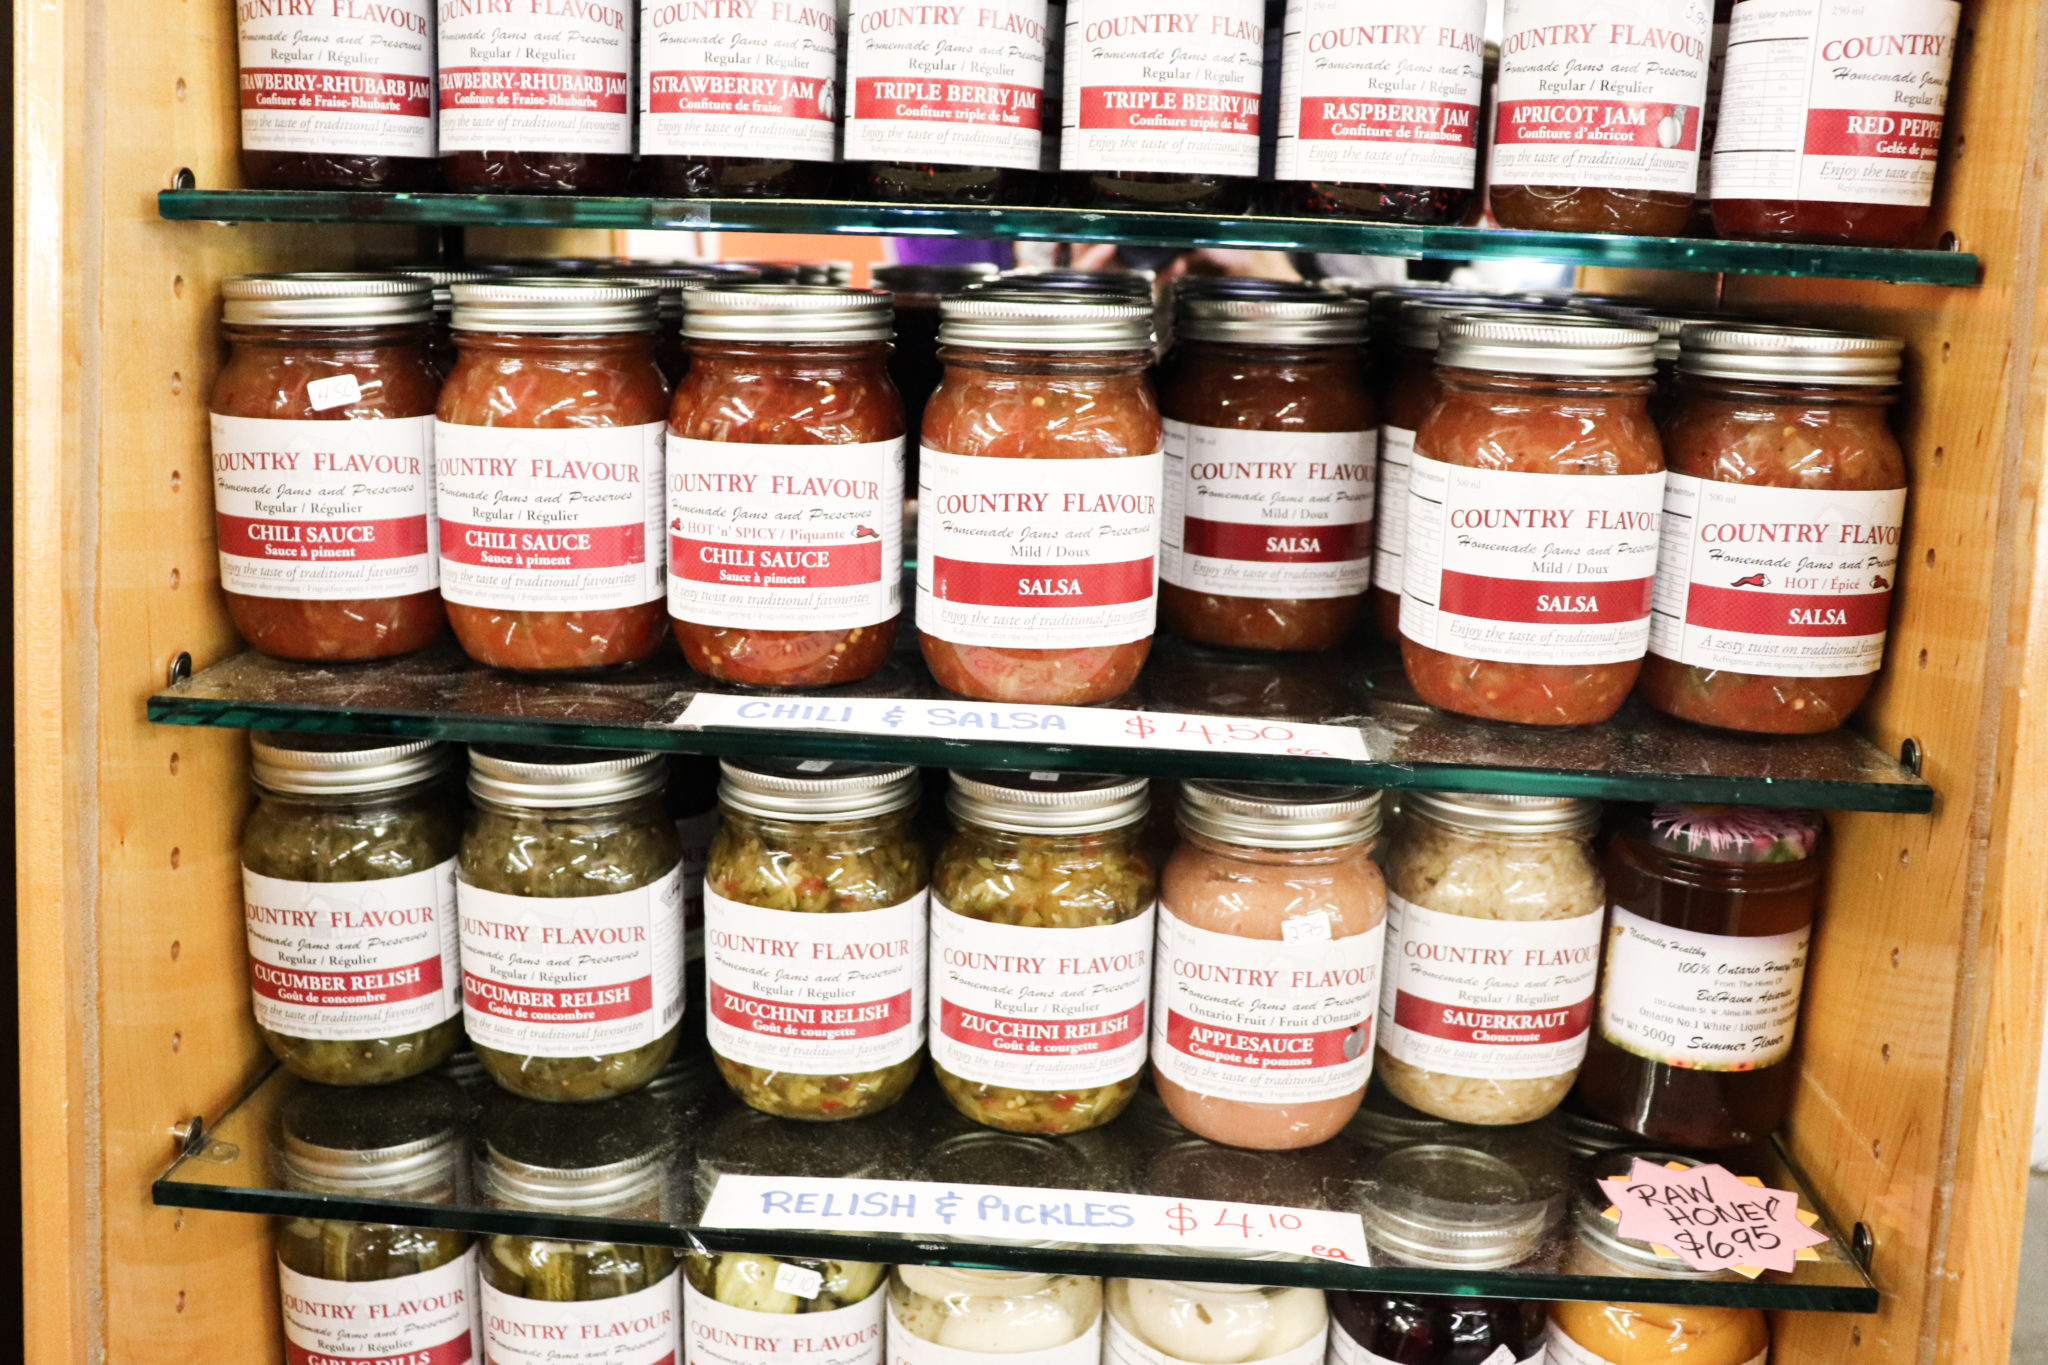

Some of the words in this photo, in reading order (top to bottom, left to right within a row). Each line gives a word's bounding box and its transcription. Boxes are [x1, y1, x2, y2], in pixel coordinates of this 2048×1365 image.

[653, 0, 760, 28] COUNTRY
[861, 6, 965, 34] COUNTRY
[1086, 13, 1200, 43] COUNTRY
[1308, 24, 1427, 53] COUNTRY
[1502, 23, 1598, 59] COUNTRY
[1609, 24, 1704, 62] FLAVOUR
[1823, 34, 1945, 61] COUNTRY
[1563, 58, 1604, 77] Jams
[1610, 61, 1641, 74] and
[1832, 67, 1916, 84] Homemade
[409, 81, 429, 100] JAM
[605, 79, 626, 96] JAM
[652, 76, 777, 96] STRAWBERRY
[780, 80, 814, 100] JAM
[873, 82, 942, 100] TRIPLE
[947, 84, 1010, 105] BERRY
[1011, 90, 1036, 110] JAM
[1539, 79, 1586, 95] Regular
[1600, 79, 1654, 96] Régulier
[679, 98, 732, 110] Confiture
[735, 99, 749, 111] de
[752, 100, 784, 112] fraise
[1103, 91, 1177, 109] TRIPLE
[1181, 93, 1240, 113] BERRY
[1894, 91, 1933, 108] Regular
[896, 104, 954, 118] Confiture
[955, 108, 986, 123] triple
[988, 110, 1000, 122] de
[1322, 102, 1440, 124] RASPBERRY
[1443, 108, 1470, 129] JAM
[1511, 105, 1599, 124] APRICOT
[1601, 106, 1648, 128] JAM
[1331, 123, 1393, 137] Confiture
[1399, 126, 1412, 138] de
[1414, 126, 1462, 142] framboise
[1517, 126, 1571, 140] Confiture
[1574, 126, 1635, 142] d'abricot
[1847, 115, 1895, 135] RED
[1899, 117, 1942, 139] PEPPE
[1876, 141, 1907, 155] Gelée
[1909, 141, 1920, 154] de
[1820, 161, 1860, 180] Enjoy
[1863, 162, 1881, 178] the
[1885, 165, 1910, 180] taste
[213, 451, 301, 472] COUNTRY
[313, 452, 421, 475] FLAVOUR
[531, 459, 640, 483] FLAVOUR
[1190, 462, 1297, 480] COUNTRY
[771, 475, 879, 500] FLAVOUR
[937, 493, 1049, 514] COUNTRY
[1062, 493, 1156, 514] FLAVOUR
[1450, 508, 1575, 529] COUNTRY
[248, 524, 302, 542] CHILI
[306, 525, 376, 543] SAUCE
[465, 529, 517, 549] CHILI
[522, 533, 591, 550] SAUCE
[688, 521, 714, 535] HOT
[736, 526, 777, 540] SPICY
[790, 529, 846, 543] Piquante
[1700, 522, 1830, 544] COUNTRY
[265, 544, 298, 556] Sauce
[301, 544, 308, 557] à
[311, 546, 356, 561] piment
[1010, 545, 1041, 558] Mild
[1056, 545, 1090, 558] Doux
[1266, 537, 1321, 553] SALSA
[700, 546, 756, 567] CHILI
[760, 551, 830, 568] SAUCE
[1532, 561, 1563, 574] Mild
[1577, 562, 1609, 575] Doux
[1708, 548, 1792, 569] Homemade
[1018, 578, 1083, 596] SALSA
[1784, 576, 1819, 589] HOT
[1536, 595, 1599, 613] SALSA
[1788, 608, 1847, 625] SALSA
[1701, 634, 1713, 646] A
[1715, 638, 1745, 654] zesty
[1748, 639, 1779, 654] twist
[1782, 644, 1798, 655] on
[1800, 639, 1859, 656] traditional
[736, 701, 853, 723] CHILI
[881, 705, 906, 728] &
[926, 707, 1067, 731] SALSA
[330, 906, 434, 928] FLAVOUR
[542, 926, 646, 945] FLAVOUR
[710, 928, 799, 958] COUNTRY
[812, 939, 909, 960] FLAVOUR
[1404, 940, 1513, 966] COUNTRY
[1670, 940, 1707, 957] Healthy
[944, 947, 1046, 975] COUNTRY
[1059, 950, 1146, 975] FLAVOUR
[1677, 961, 1711, 973] 100%
[1717, 962, 1760, 976] Ontario
[254, 963, 347, 991] CUCUMBER
[352, 967, 421, 991] RELISH
[1173, 958, 1280, 988] COUNTRY
[1714, 979, 1736, 987] From
[1739, 979, 1753, 987] The
[465, 976, 556, 1008] CUCUMBER
[560, 986, 630, 1008] RELISH
[724, 993, 815, 1024] ZUCCHINI
[821, 1003, 889, 1024] RELISH
[1188, 1002, 1233, 1022] Ontario
[1236, 1011, 1266, 1026] Fruit
[1279, 1015, 1309, 1027] Fruit
[1311, 1010, 1362, 1026] d'Ontario
[1442, 1009, 1569, 1029] SAUERKRAUT
[961, 1012, 1059, 1040] ZUCCHINI
[1064, 1015, 1129, 1040] RELISH
[1639, 1007, 1674, 1025] Ontario
[1703, 1018, 1732, 1031] White
[1740, 1018, 1767, 1033] Liquid
[993, 1038, 1024, 1052] Goût
[1026, 1041, 1042, 1053] de
[1044, 1041, 1099, 1055] courgette
[1189, 1026, 1314, 1053] APPLESAUCE
[1472, 1030, 1540, 1042] Choucroute
[1642, 1024, 1676, 1047] 500g
[1687, 1036, 1746, 1051] Summer
[1188, 1042, 1242, 1064] Compote
[1245, 1053, 1259, 1065] de
[1262, 1056, 1313, 1069] pommes
[1626, 1175, 1715, 1207] RAW
[1664, 1195, 1781, 1227] HONEY
[760, 1190, 917, 1218] RELISH
[935, 1191, 964, 1225] &
[977, 1194, 1135, 1228] PICKLES
[1311, 1245, 1356, 1262] ea
[1674, 1225, 1782, 1260] $6.95
[368, 1288, 464, 1319] FLAVOUR
[691, 1319, 780, 1352] COUNTRY
[791, 1323, 879, 1352] FLAVOUR
